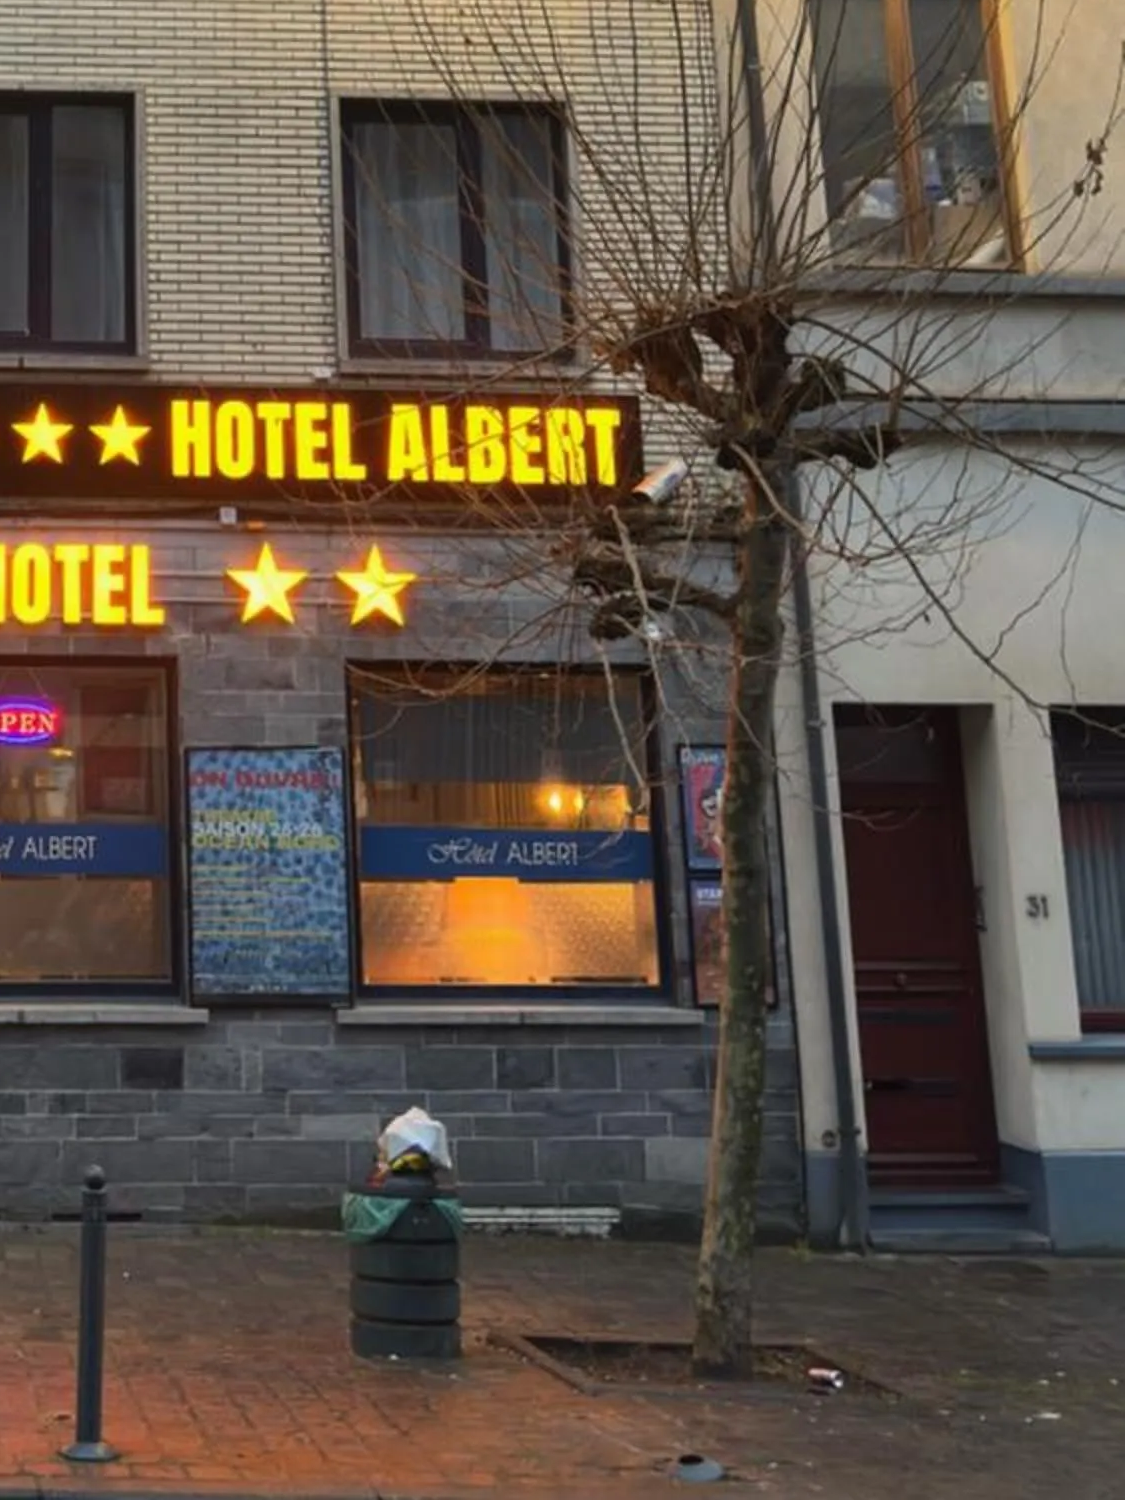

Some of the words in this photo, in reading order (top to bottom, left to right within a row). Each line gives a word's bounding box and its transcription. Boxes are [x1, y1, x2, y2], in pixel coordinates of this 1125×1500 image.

[170, 399, 366, 480] HOTEL
[388, 403, 621, 486] ALBERT
[21, 836, 97, 861] ALBERT
[506, 841, 578, 866] ALBERT
[1026, 895, 1049, 919] 31
